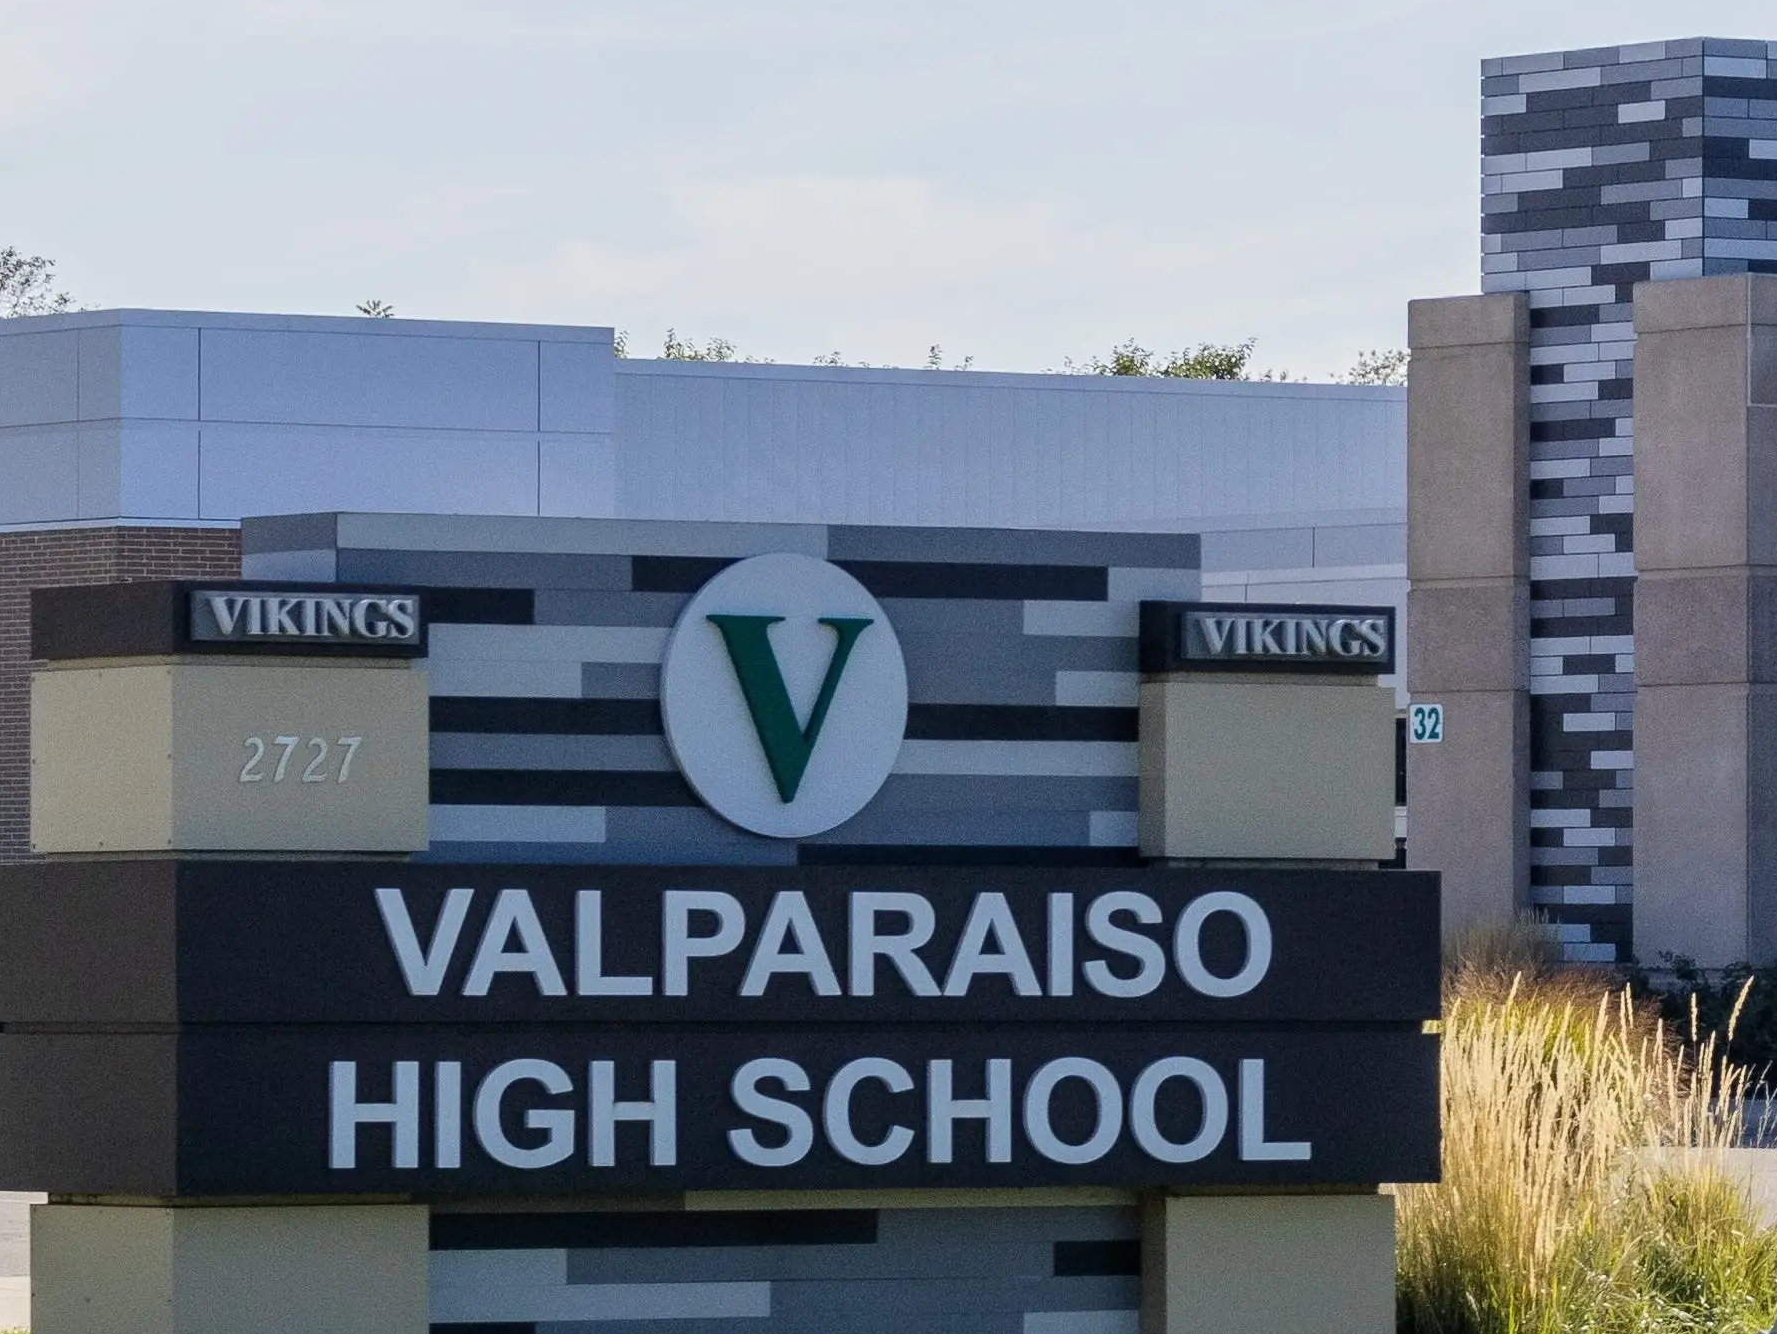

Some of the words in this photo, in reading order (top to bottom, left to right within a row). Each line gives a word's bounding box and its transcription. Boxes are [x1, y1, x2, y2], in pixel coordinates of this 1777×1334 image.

[208, 596, 416, 639] VIKINGS
[1197, 617, 1387, 657] VIKINGS
[707, 613, 872, 805] V
[1413, 706, 1441, 741] 32
[239, 734, 362, 784] 2727
[374, 887, 1273, 999] VALPARAISO
[327, 1057, 677, 1170] HIGH
[726, 1055, 1313, 1167] SCHOOL
